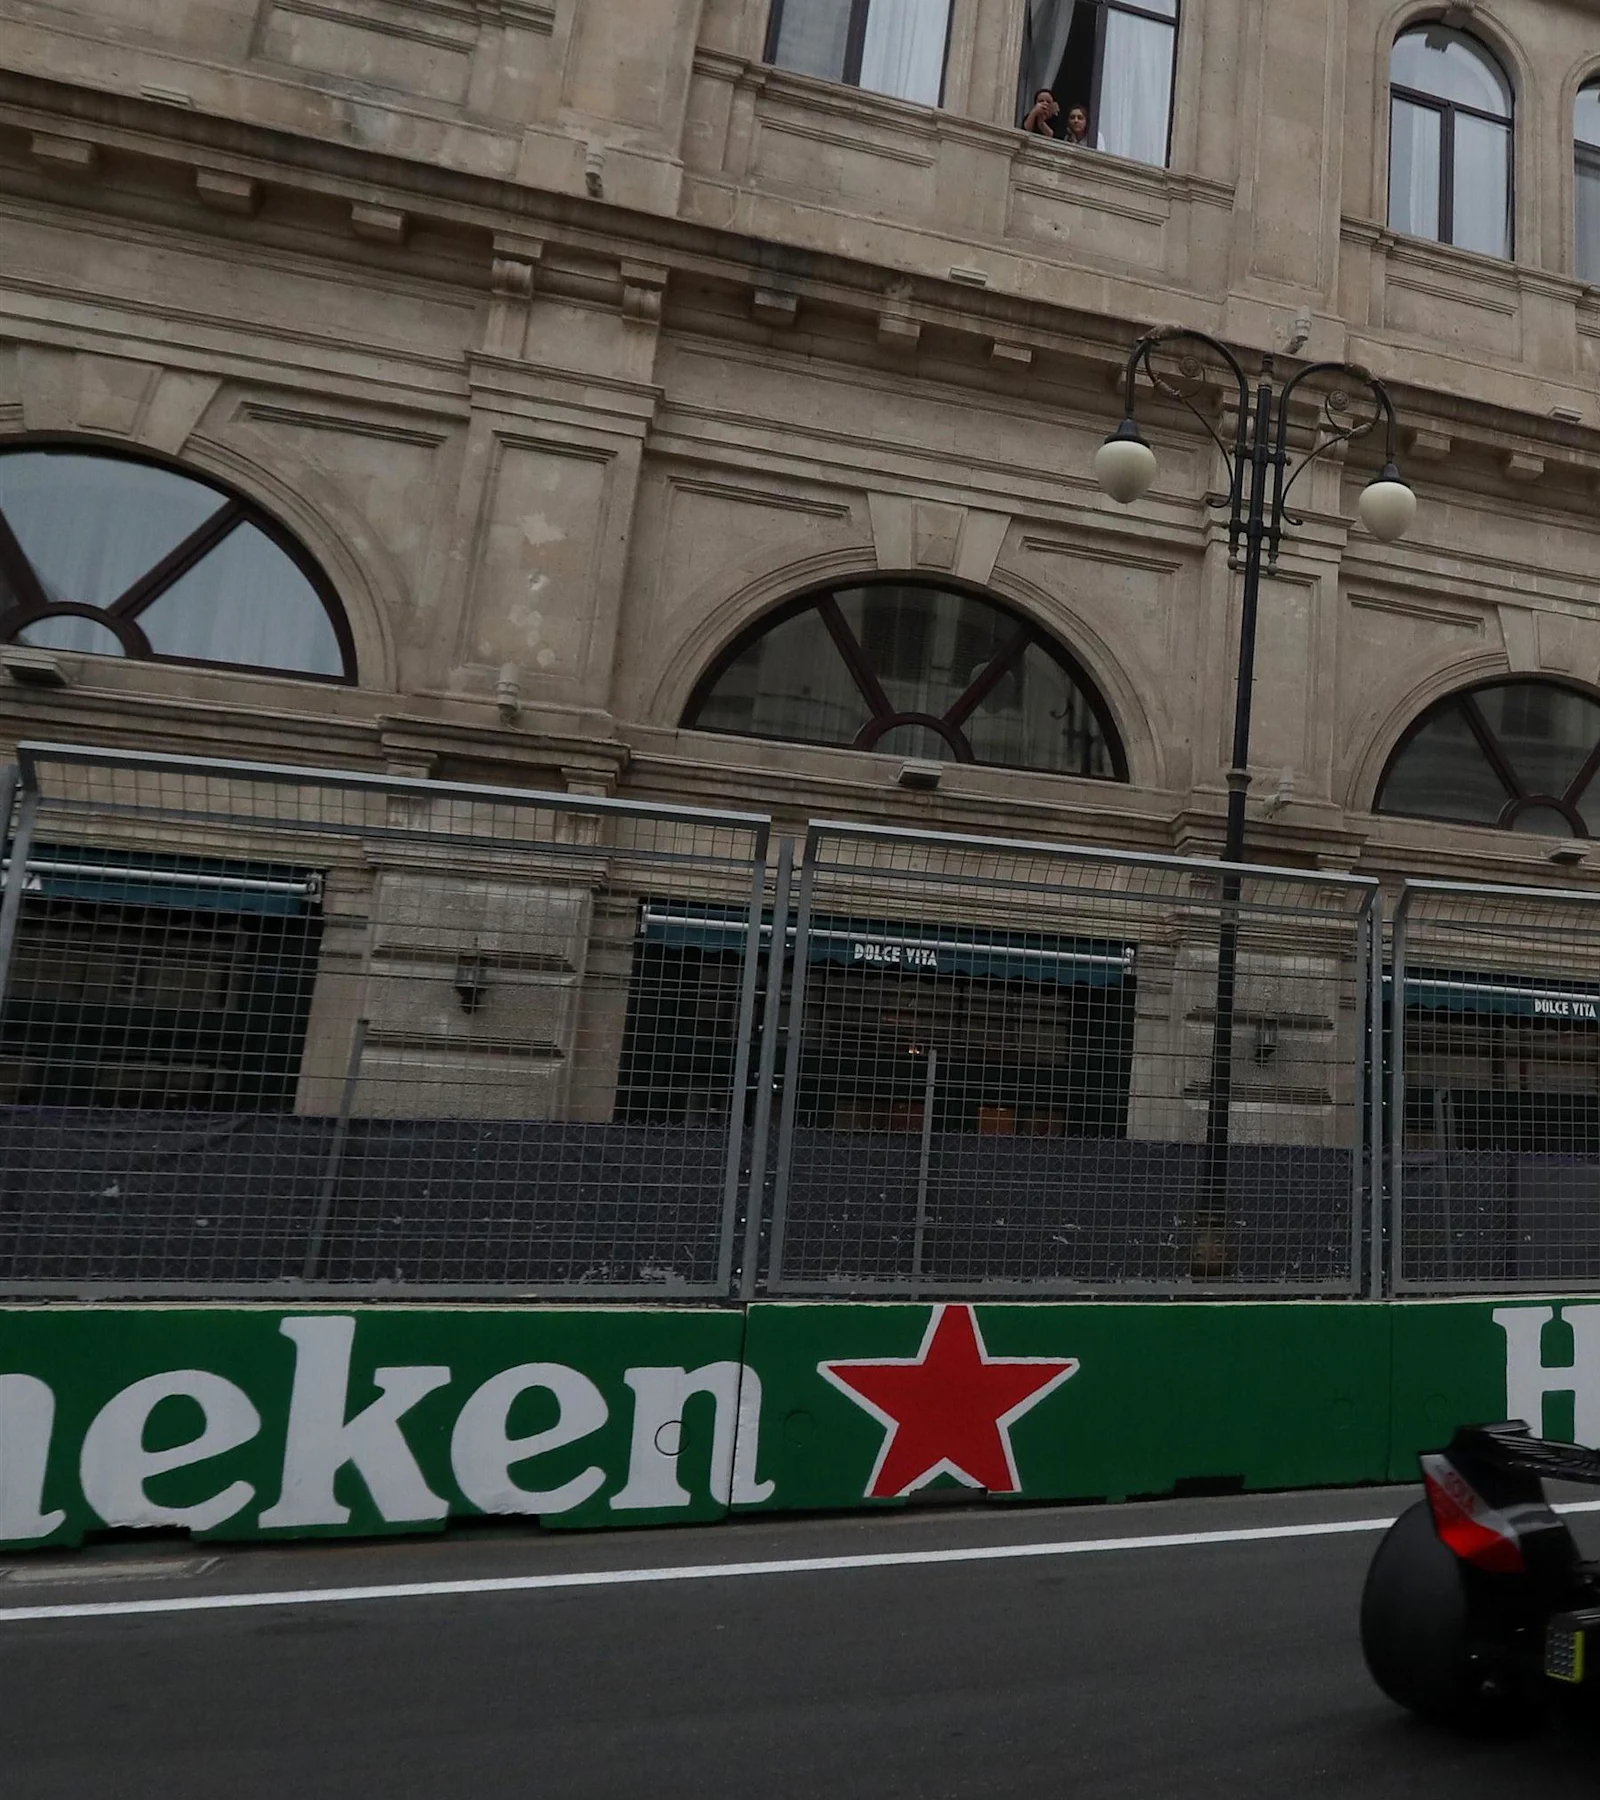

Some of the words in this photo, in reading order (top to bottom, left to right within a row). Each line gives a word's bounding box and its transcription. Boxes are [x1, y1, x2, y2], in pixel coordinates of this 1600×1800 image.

[854, 943, 901, 962] DOLCE
[905, 947, 938, 966] VITA
[1534, 998, 1569, 1015] DOLCE
[1571, 1002, 1596, 1018] VITA
